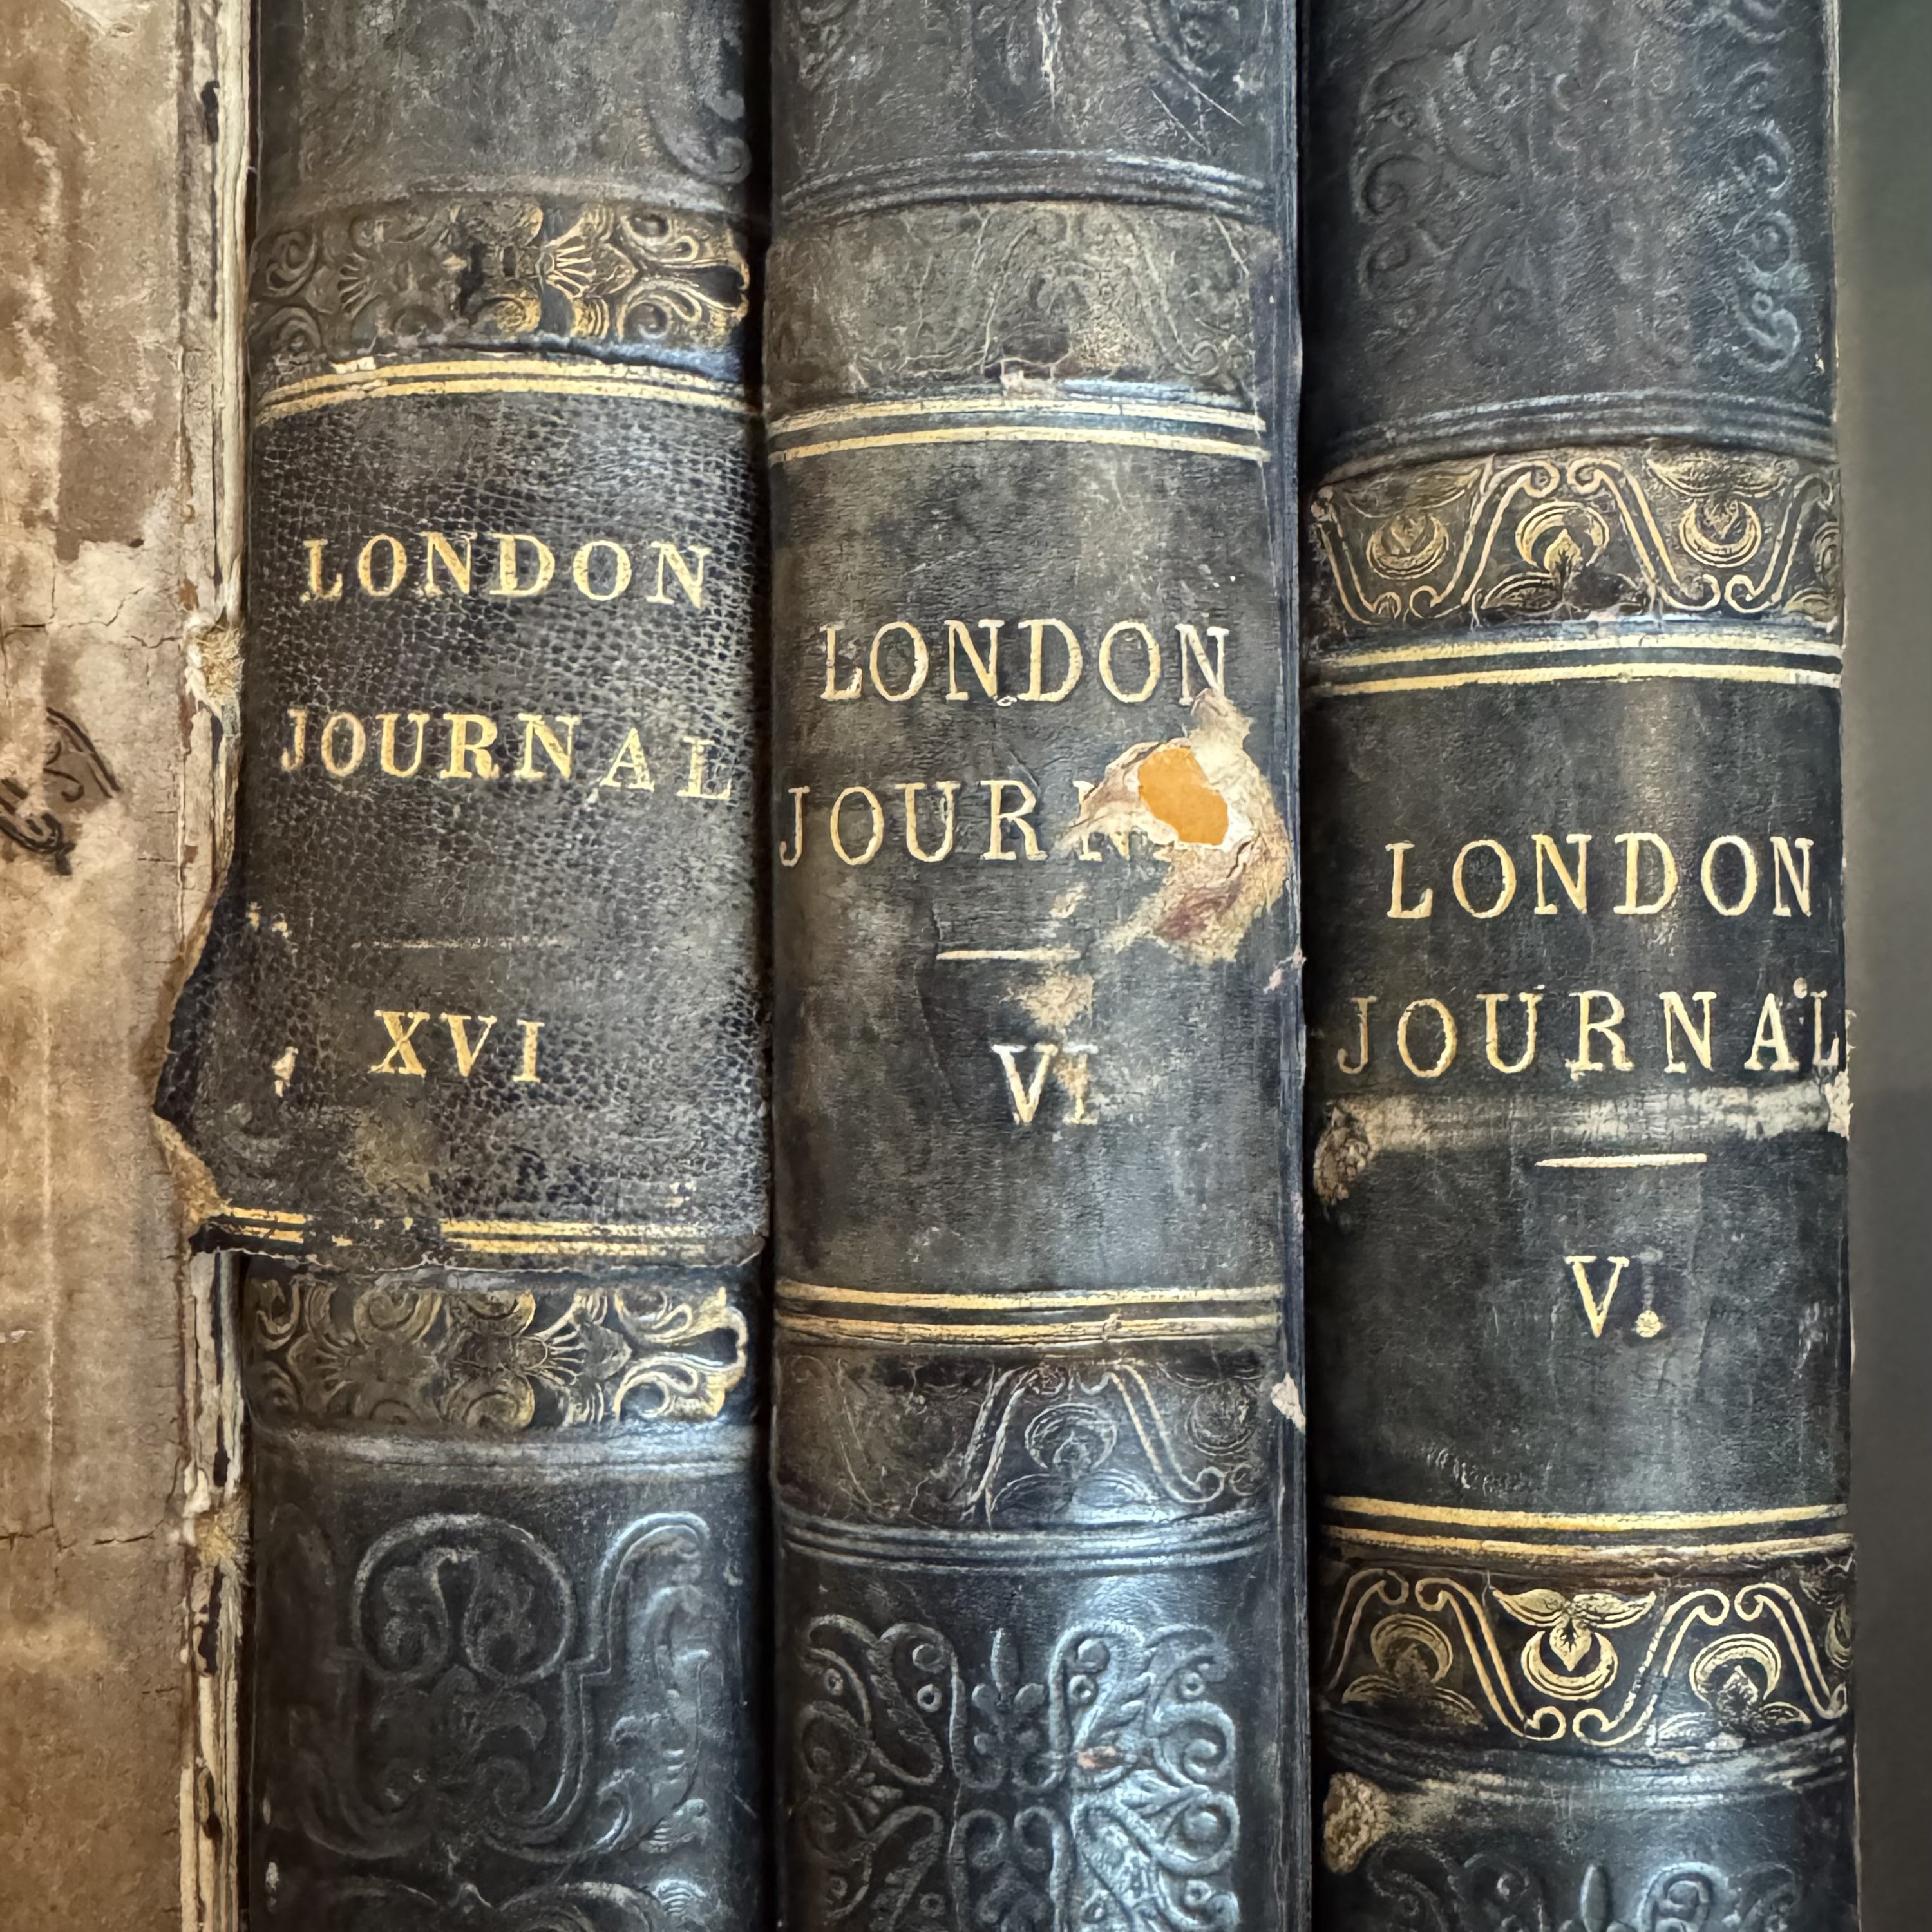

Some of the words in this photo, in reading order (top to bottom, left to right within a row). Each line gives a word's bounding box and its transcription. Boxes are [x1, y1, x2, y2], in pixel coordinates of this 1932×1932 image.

[300, 531, 711, 610] LONDON
[819, 618, 1231, 708] LONDON
[281, 708, 733, 802] JOURNAL
[1385, 832, 1814, 919] LONDON
[368, 1009, 546, 1084] XVI
[1336, 990, 1841, 1078] JOURNAL
